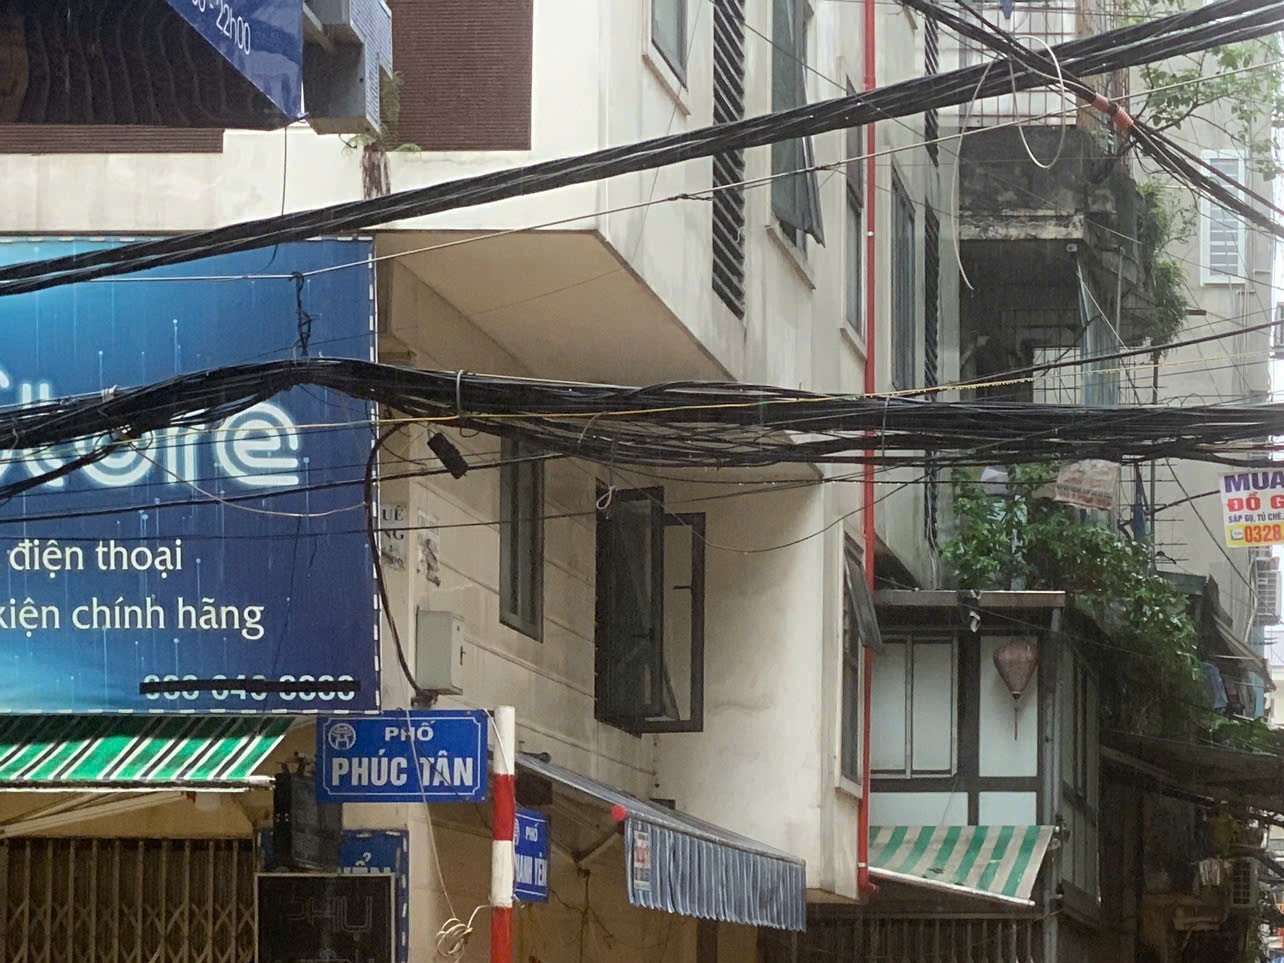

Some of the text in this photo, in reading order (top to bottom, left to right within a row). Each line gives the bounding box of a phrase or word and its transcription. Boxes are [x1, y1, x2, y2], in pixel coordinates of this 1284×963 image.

[1227, 491, 1261, 512] ĐỒ
[9, 539, 182, 578] điện thoại
[72, 596, 165, 629] chính
[177, 597, 264, 640] hãng
[384, 720, 436, 741] PHỐ
[332, 748, 473, 786] PHÚC TÂN
